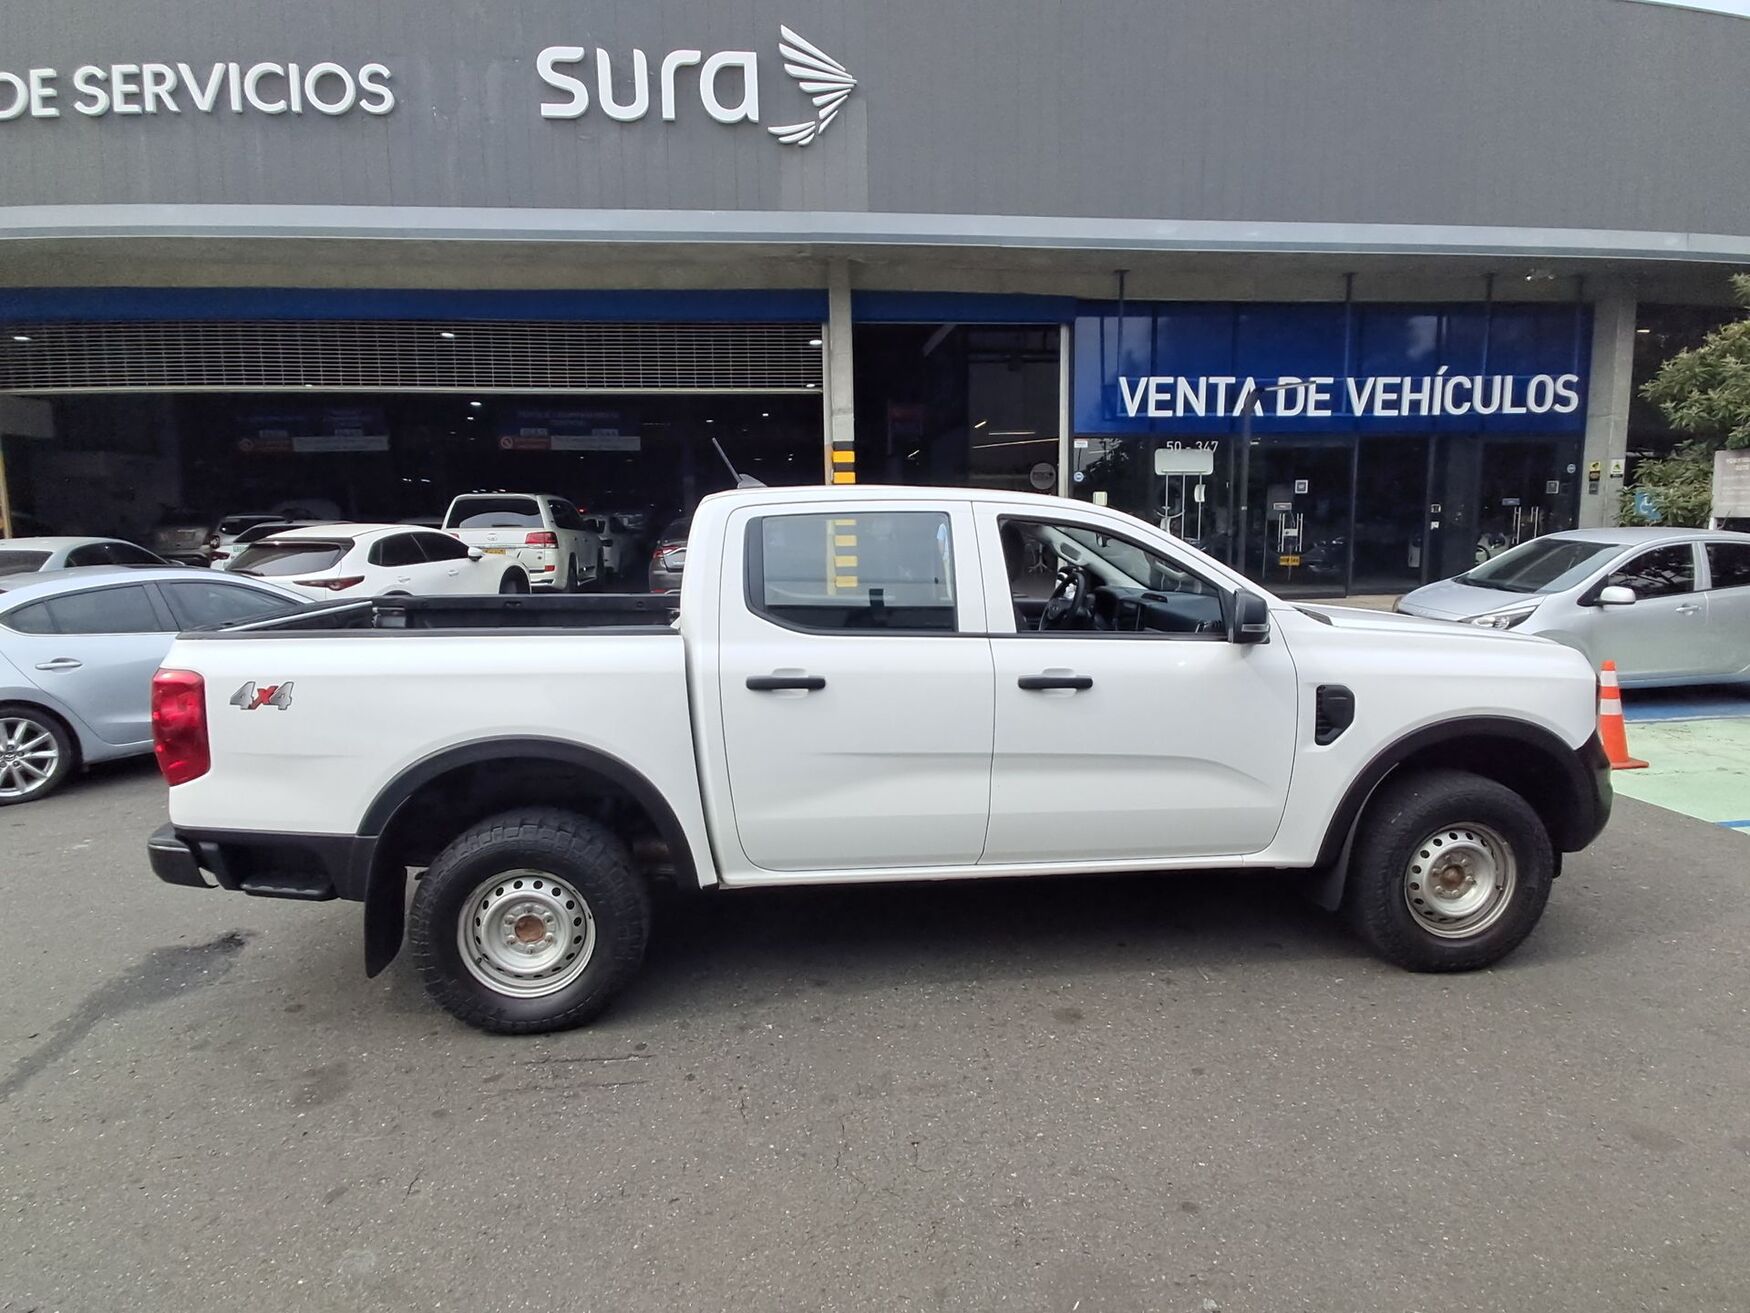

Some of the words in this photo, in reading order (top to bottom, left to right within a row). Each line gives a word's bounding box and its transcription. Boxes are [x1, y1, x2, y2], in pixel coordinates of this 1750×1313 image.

[0, 68, 60, 121] DE
[73, 61, 396, 117] SERVICIOS
[538, 46, 760, 123] sura
[1118, 376, 1263, 418] VENTA
[1277, 376, 1334, 418] DE
[1347, 365, 1580, 418] VEHÍCULOS
